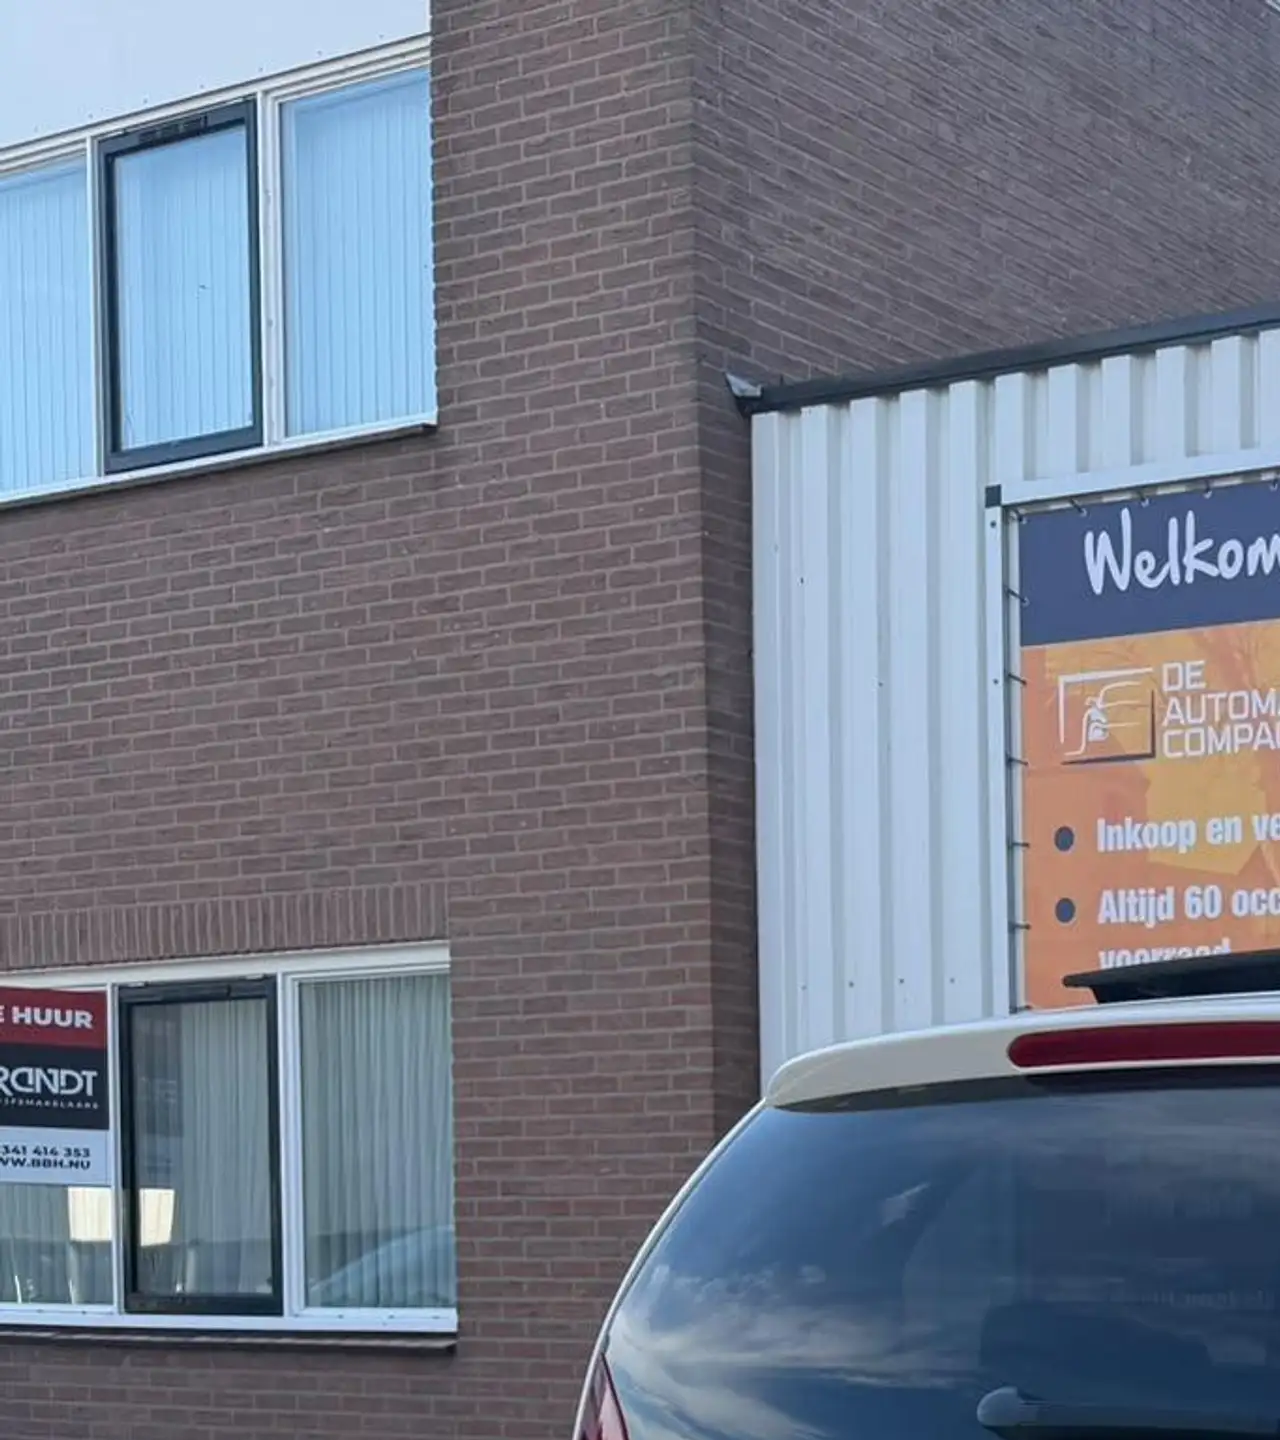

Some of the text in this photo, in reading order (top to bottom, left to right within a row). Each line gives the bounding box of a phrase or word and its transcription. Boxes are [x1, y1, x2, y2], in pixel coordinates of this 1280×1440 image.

[1162, 660, 1206, 692] DE
[1097, 816, 1197, 854] Inkoop
[1206, 815, 1242, 845] en
[1098, 886, 1175, 928] Altijd
[1184, 884, 1222, 919] 60
[11, 1005, 93, 1029] HUUR
